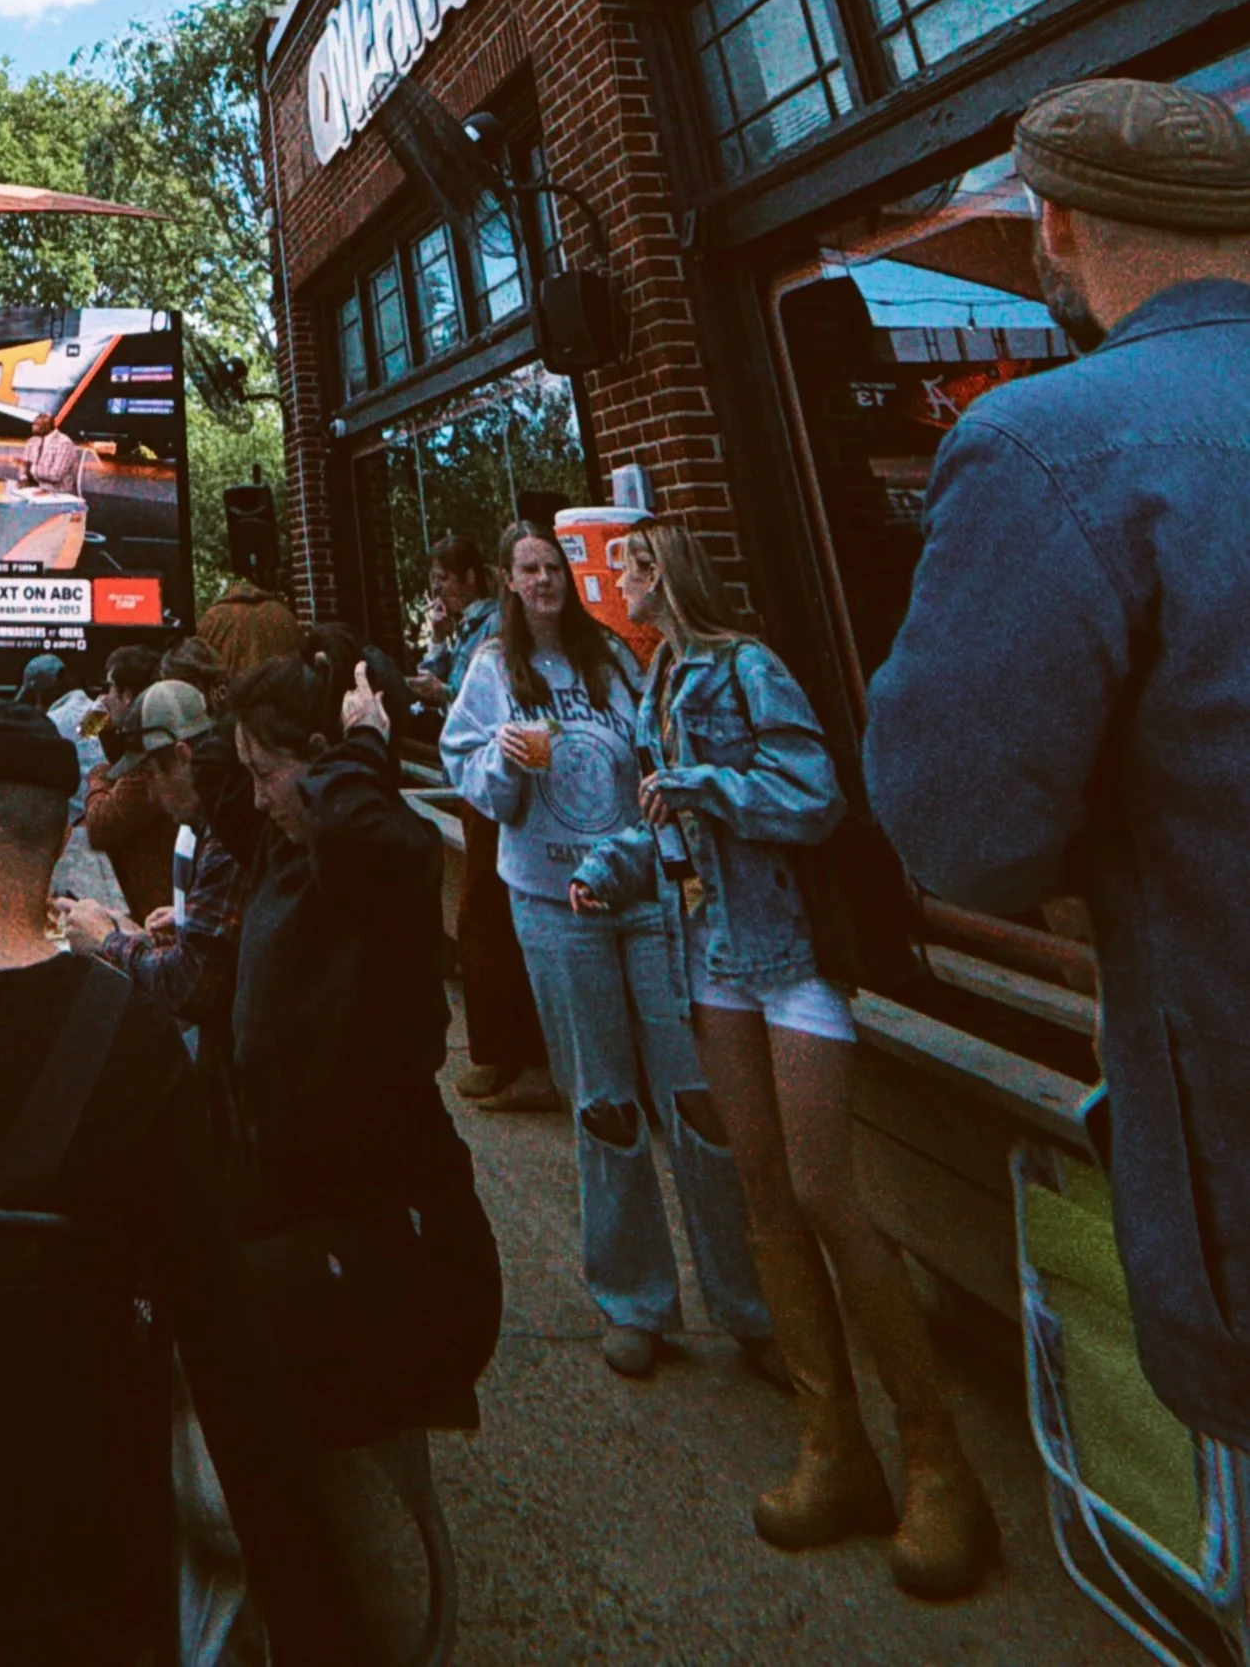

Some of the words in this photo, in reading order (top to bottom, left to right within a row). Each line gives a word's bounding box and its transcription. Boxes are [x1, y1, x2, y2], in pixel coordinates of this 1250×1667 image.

[12, 563, 38, 572] FIRM
[23, 586, 47, 600] ON
[50, 587, 83, 601] ABC
[30, 605, 55, 614] since
[58, 605, 81, 615] 2013
